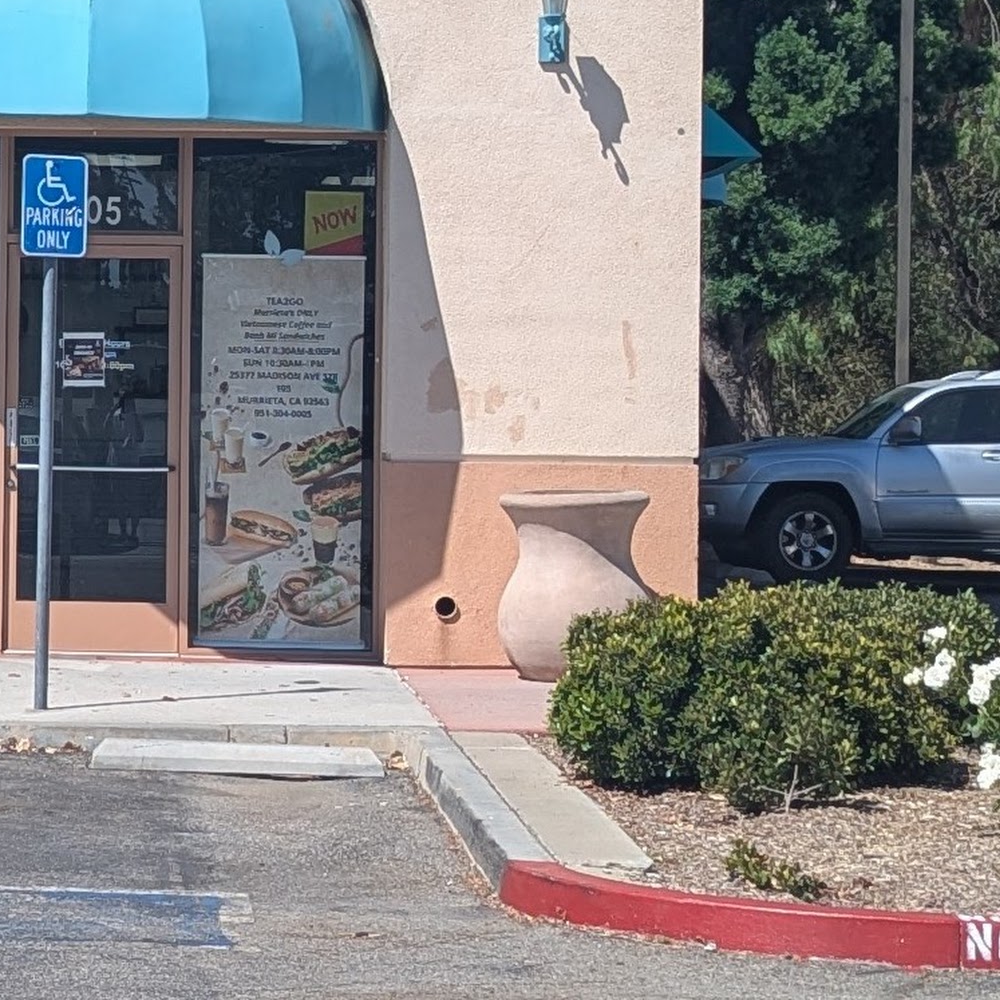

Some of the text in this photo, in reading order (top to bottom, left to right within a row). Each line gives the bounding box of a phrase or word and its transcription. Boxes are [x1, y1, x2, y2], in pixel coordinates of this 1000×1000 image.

[25, 206, 83, 228] PARKING
[311, 204, 357, 235] NOW
[36, 229, 71, 250] ONLY
[266, 297, 304, 306] TEA2GO
[289, 321, 315, 330] Coffee
[243, 359, 262, 367] SUN
[257, 371, 301, 380] MADISON
[303, 372, 320, 380] AVE
[289, 397, 301, 405] CA
[966, 922, 1000, 962] N
